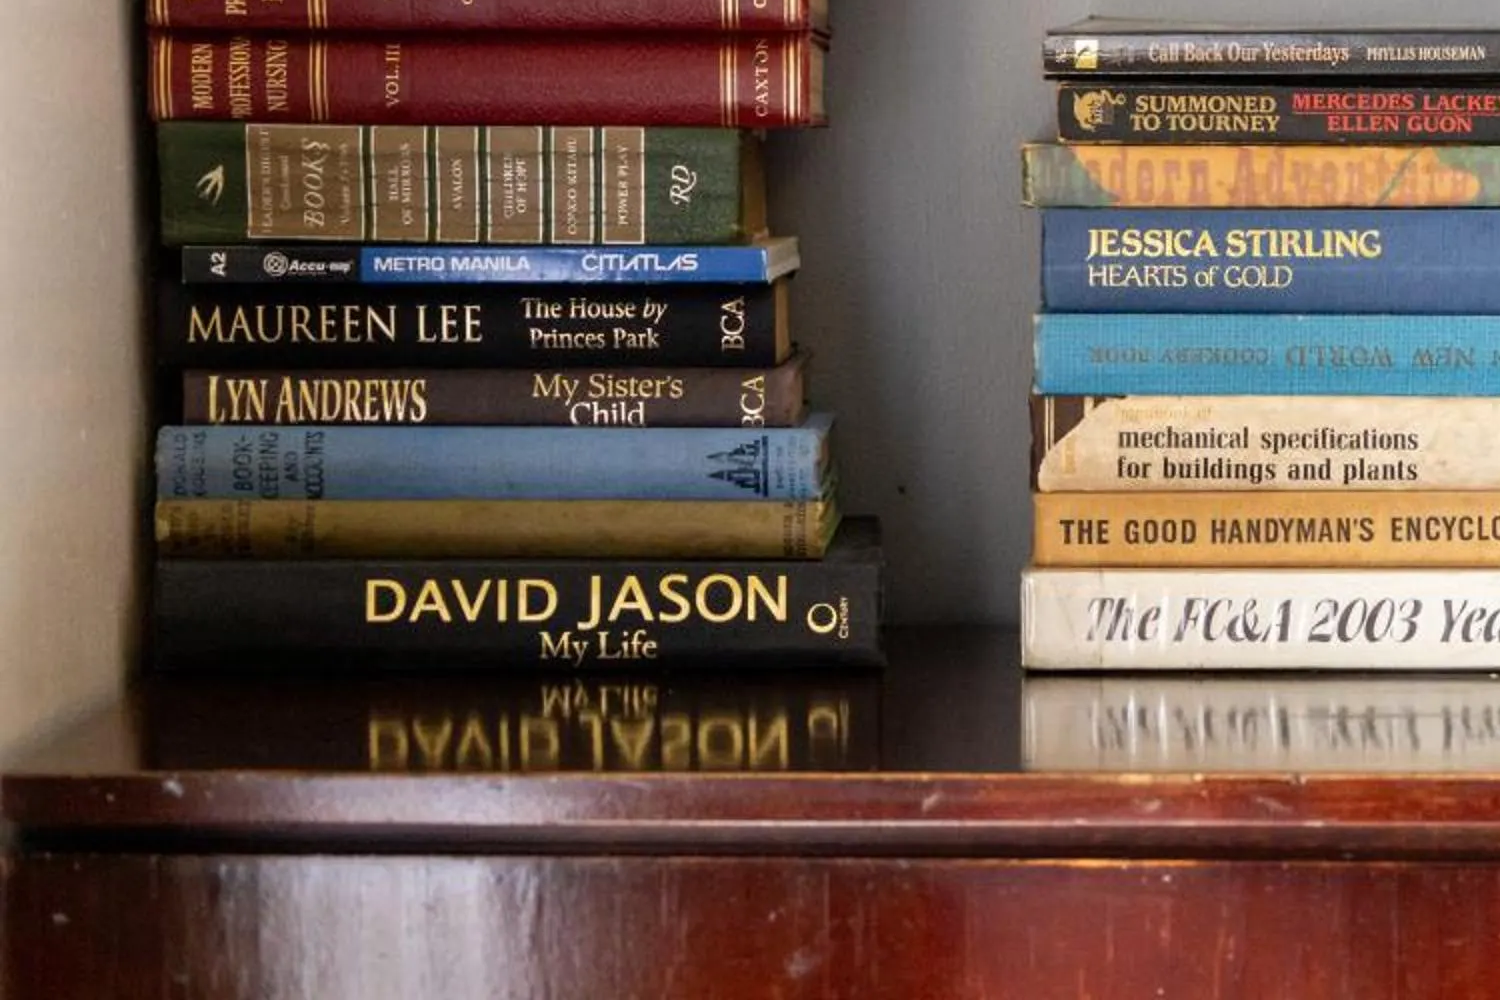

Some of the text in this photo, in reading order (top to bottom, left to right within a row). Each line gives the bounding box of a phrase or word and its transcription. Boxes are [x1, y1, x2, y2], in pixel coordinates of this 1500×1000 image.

[1149, 42, 1350, 65] Call Back Our Yesterdays
[1366, 46, 1486, 62] PHYLLIS HOUSEMAN
[192, 43, 213, 111] MODERN
[265, 40, 289, 113] NURSING
[755, 38, 769, 117] CAXTON
[1135, 95, 1277, 114] SUMMONED
[1292, 93, 1415, 111] MERCEDES
[1130, 114, 1280, 132] TO TOURNEY
[1327, 114, 1473, 132] ELLEN GUON
[301, 137, 331, 228] BOOKS
[451, 158, 464, 211] AVALON
[615, 144, 630, 226] POWER PLAY
[669, 164, 698, 206] RD
[1086, 229, 1382, 260] JESSICA STIRLING
[210, 252, 227, 277] A2
[374, 256, 444, 273] METRO
[451, 255, 531, 271] MANILA
[1088, 265, 1294, 289] HEARTS of GOLD
[187, 304, 482, 343] MAUREEN LEE
[520, 297, 668, 325] The House by
[721, 296, 746, 351] BCA
[530, 327, 660, 349] Princes Park
[1284, 345, 1394, 370] WORLD
[208, 375, 428, 425] LYN ANDREWS
[533, 373, 684, 406] My Sister's
[741, 374, 767, 427] BCA
[569, 401, 646, 426] Child
[1117, 426, 1419, 455] mechanical specifications
[1117, 457, 1418, 485] for buildings and plants
[1060, 518, 1110, 545] THE
[1123, 518, 1197, 545] GOOD
[1211, 516, 1376, 544] HANDYMAN'S
[365, 574, 788, 631] DAVID JASON
[1085, 597, 1162, 643] The
[1172, 597, 1293, 644] FC&A
[1307, 597, 1424, 644] 2003
[540, 630, 658, 666] My Life
